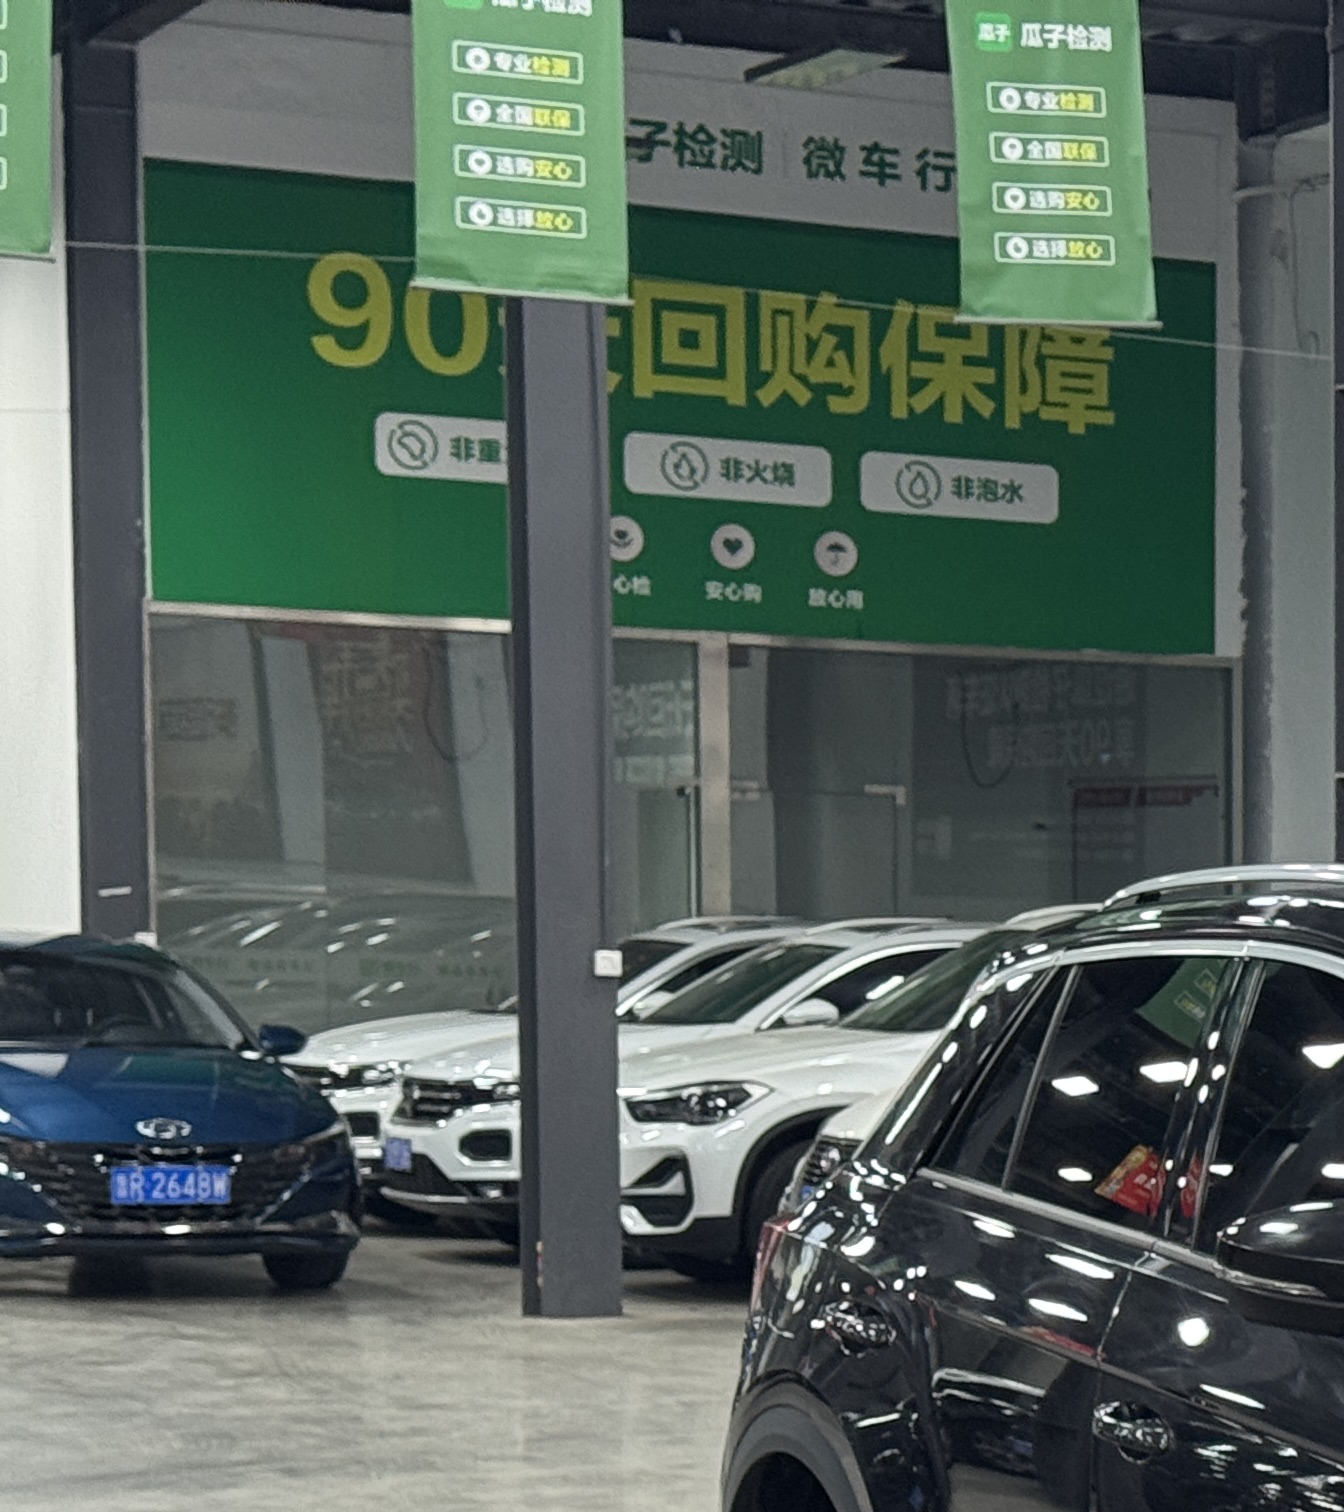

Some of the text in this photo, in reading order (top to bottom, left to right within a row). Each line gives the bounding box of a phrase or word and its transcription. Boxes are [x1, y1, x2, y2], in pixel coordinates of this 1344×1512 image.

[1020, 22, 1112, 52] 瓜子检测
[1024, 90, 1095, 112] 专业检测
[802, 136, 958, 193] 微车行
[1027, 140, 1098, 161] 全国联保
[1029, 190, 1100, 211] 选购安心
[307, 252, 1117, 435] 90回购保障
[449, 434, 506, 464] 非重
[719, 456, 796, 489] 非火烧
[950, 475, 1024, 506] 非泡水
